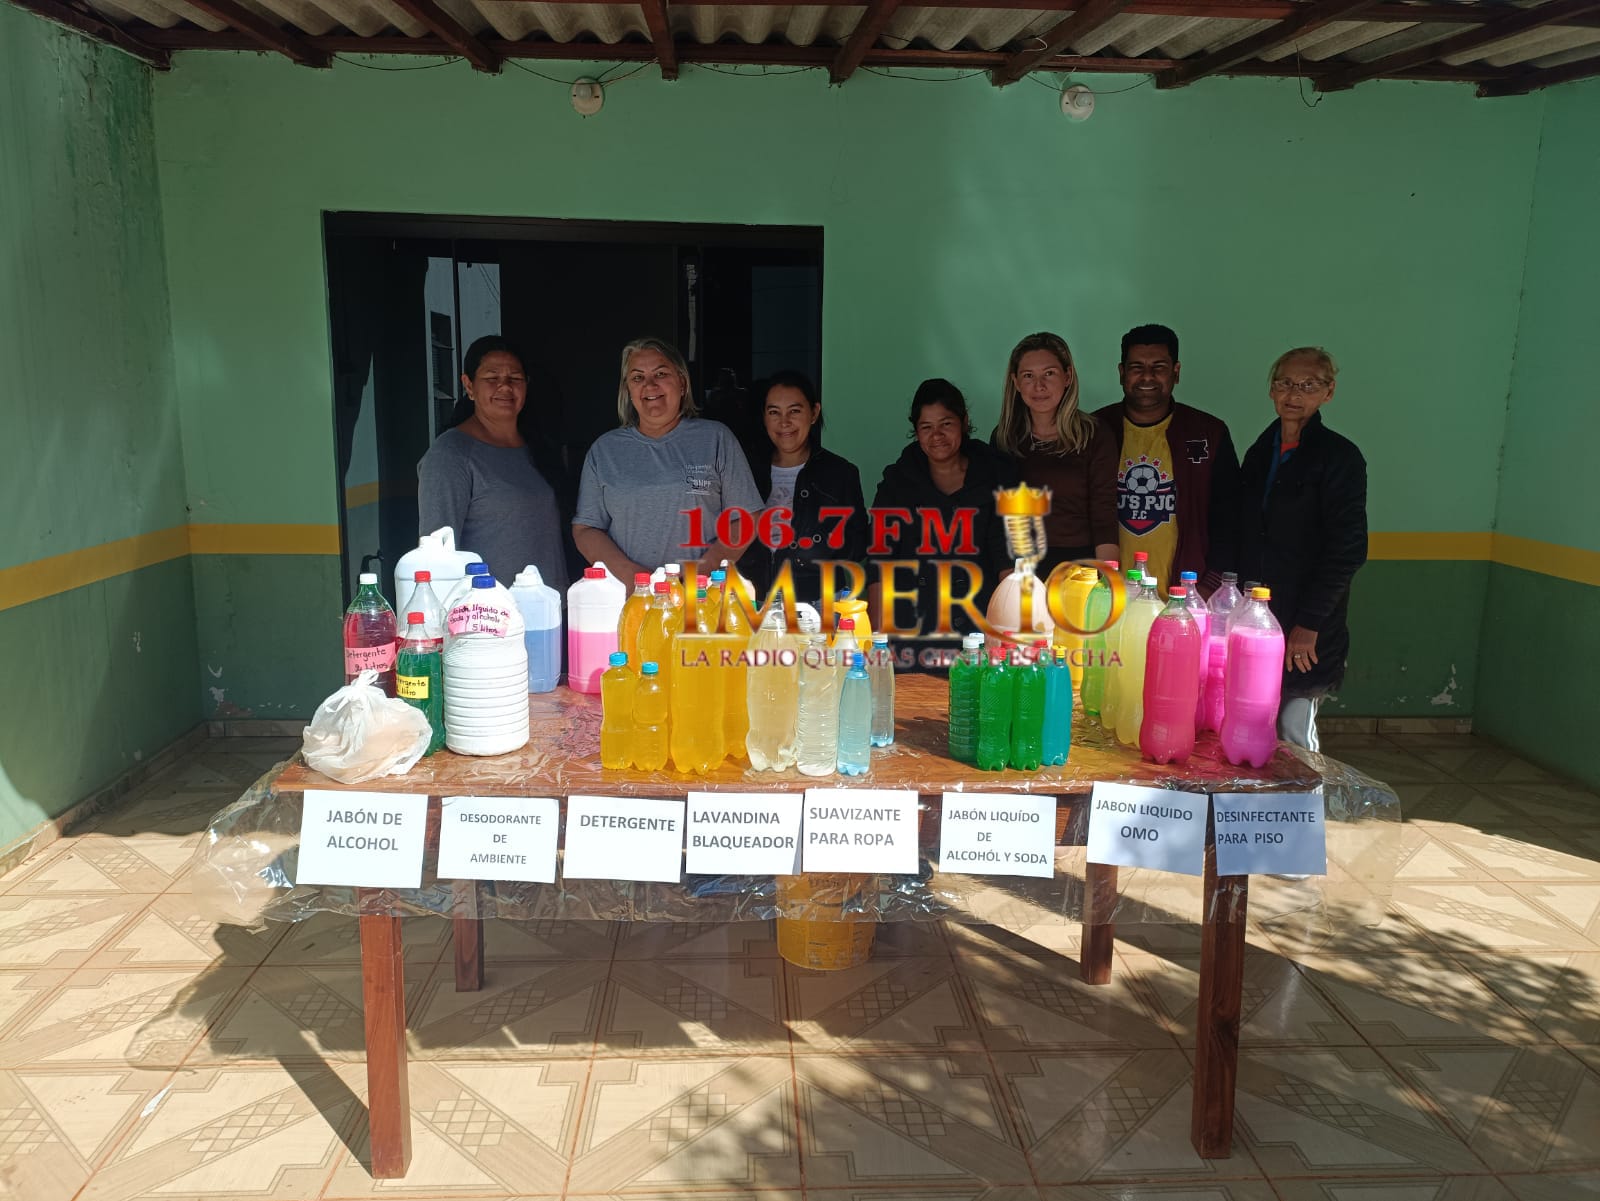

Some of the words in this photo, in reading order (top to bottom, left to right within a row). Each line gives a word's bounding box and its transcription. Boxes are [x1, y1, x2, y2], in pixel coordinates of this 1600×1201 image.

[1144, 494, 1175, 511] PJC
[1132, 510, 1147, 520] F.C
[326, 808, 378, 825] JABÓN
[383, 813, 403, 825] DE
[693, 811, 780, 825] LAVANDINA
[809, 807, 901, 822] SUAVIZANTE
[948, 808, 987, 822] JABÓN
[990, 808, 1040, 825] LIQUÍDO
[1095, 799, 1136, 814] JABON
[1139, 804, 1193, 822] LIQUIDO
[1216, 810, 1315, 824] DESINFECTANTE
[460, 813, 541, 825] DESODORANTE
[580, 814, 676, 832] DETERGENTE
[492, 834, 507, 844] DE
[809, 832, 849, 845] PARA
[854, 832, 894, 846] ROPA
[976, 832, 992, 843] DE
[1120, 825, 1159, 842] OMO
[1217, 832, 1248, 845] PARA
[1254, 832, 1284, 844] PISO
[326, 835, 399, 851] ALCOHOL
[692, 835, 794, 850] BLAQUEADOR
[470, 853, 527, 865] AMBIENTE
[946, 848, 1000, 862] ALCOHÓL
[1003, 851, 1011, 862] Y
[1014, 852, 1048, 865] SODA
